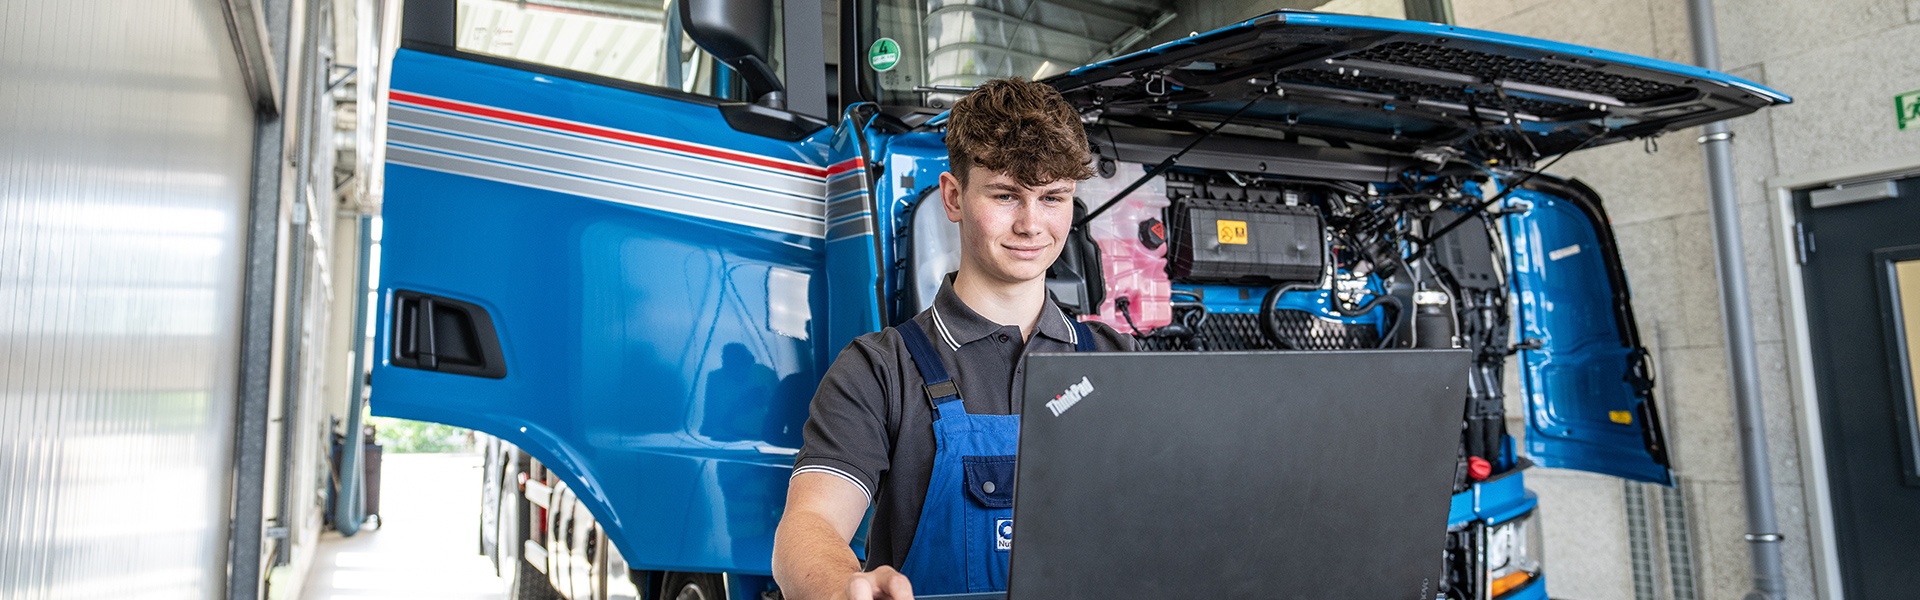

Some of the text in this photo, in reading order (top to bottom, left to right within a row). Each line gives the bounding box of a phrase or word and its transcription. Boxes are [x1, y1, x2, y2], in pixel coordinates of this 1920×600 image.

[879, 40, 888, 54] 4
[1045, 375, 1095, 418] ThinkPad
[998, 540, 1011, 548] Nu
